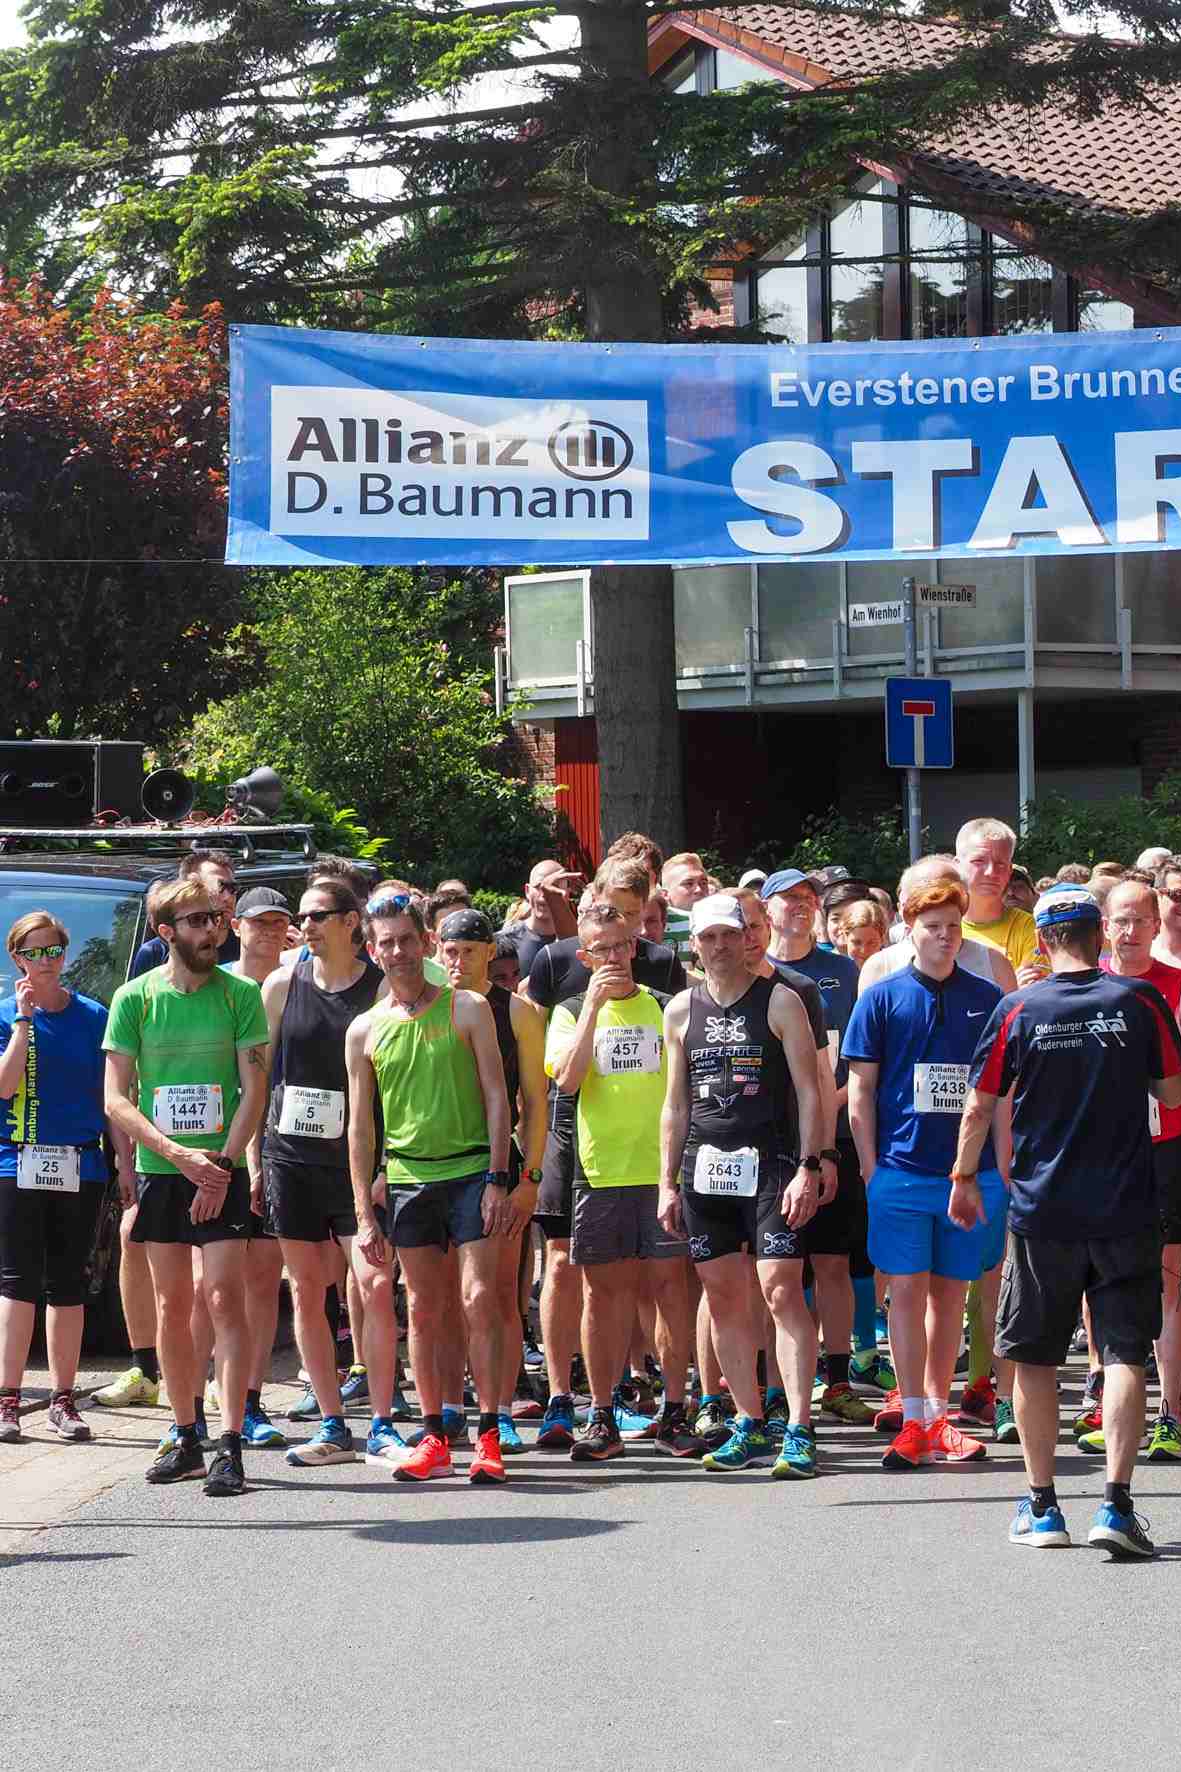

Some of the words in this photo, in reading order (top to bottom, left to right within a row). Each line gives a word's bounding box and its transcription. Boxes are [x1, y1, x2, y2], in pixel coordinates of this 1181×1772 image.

[770, 371, 1015, 409] Everstener
[287, 416, 530, 467] Allianz
[287, 471, 343, 515] D.
[359, 472, 634, 519] Baumann
[920, 585, 973, 602] Wienstraße
[852, 608, 866, 622] Am
[867, 604, 902, 621] Wienhof
[1035, 1022, 1083, 1035] Oldenburger
[613, 1042, 640, 1056] 457
[1037, 1037, 1083, 1050] Ruderverein
[611, 1056, 644, 1070] bruns
[929, 1065, 957, 1073] Allianz
[26, 1045, 37, 1098] Marathon
[168, 1087, 195, 1095] Allianz
[930, 1081, 967, 1095] 2438
[933, 1095, 964, 1108] bruns
[169, 1103, 207, 1116] 1447
[306, 1106, 316, 1119] 5
[26, 1099, 40, 1145] denburg
[172, 1117, 206, 1131] bruns
[294, 1118, 326, 1134] bruns
[41, 1160, 59, 1173] 25
[707, 1163, 742, 1177] 2643
[35, 1172, 65, 1186] bruns
[709, 1176, 738, 1191] bruns
